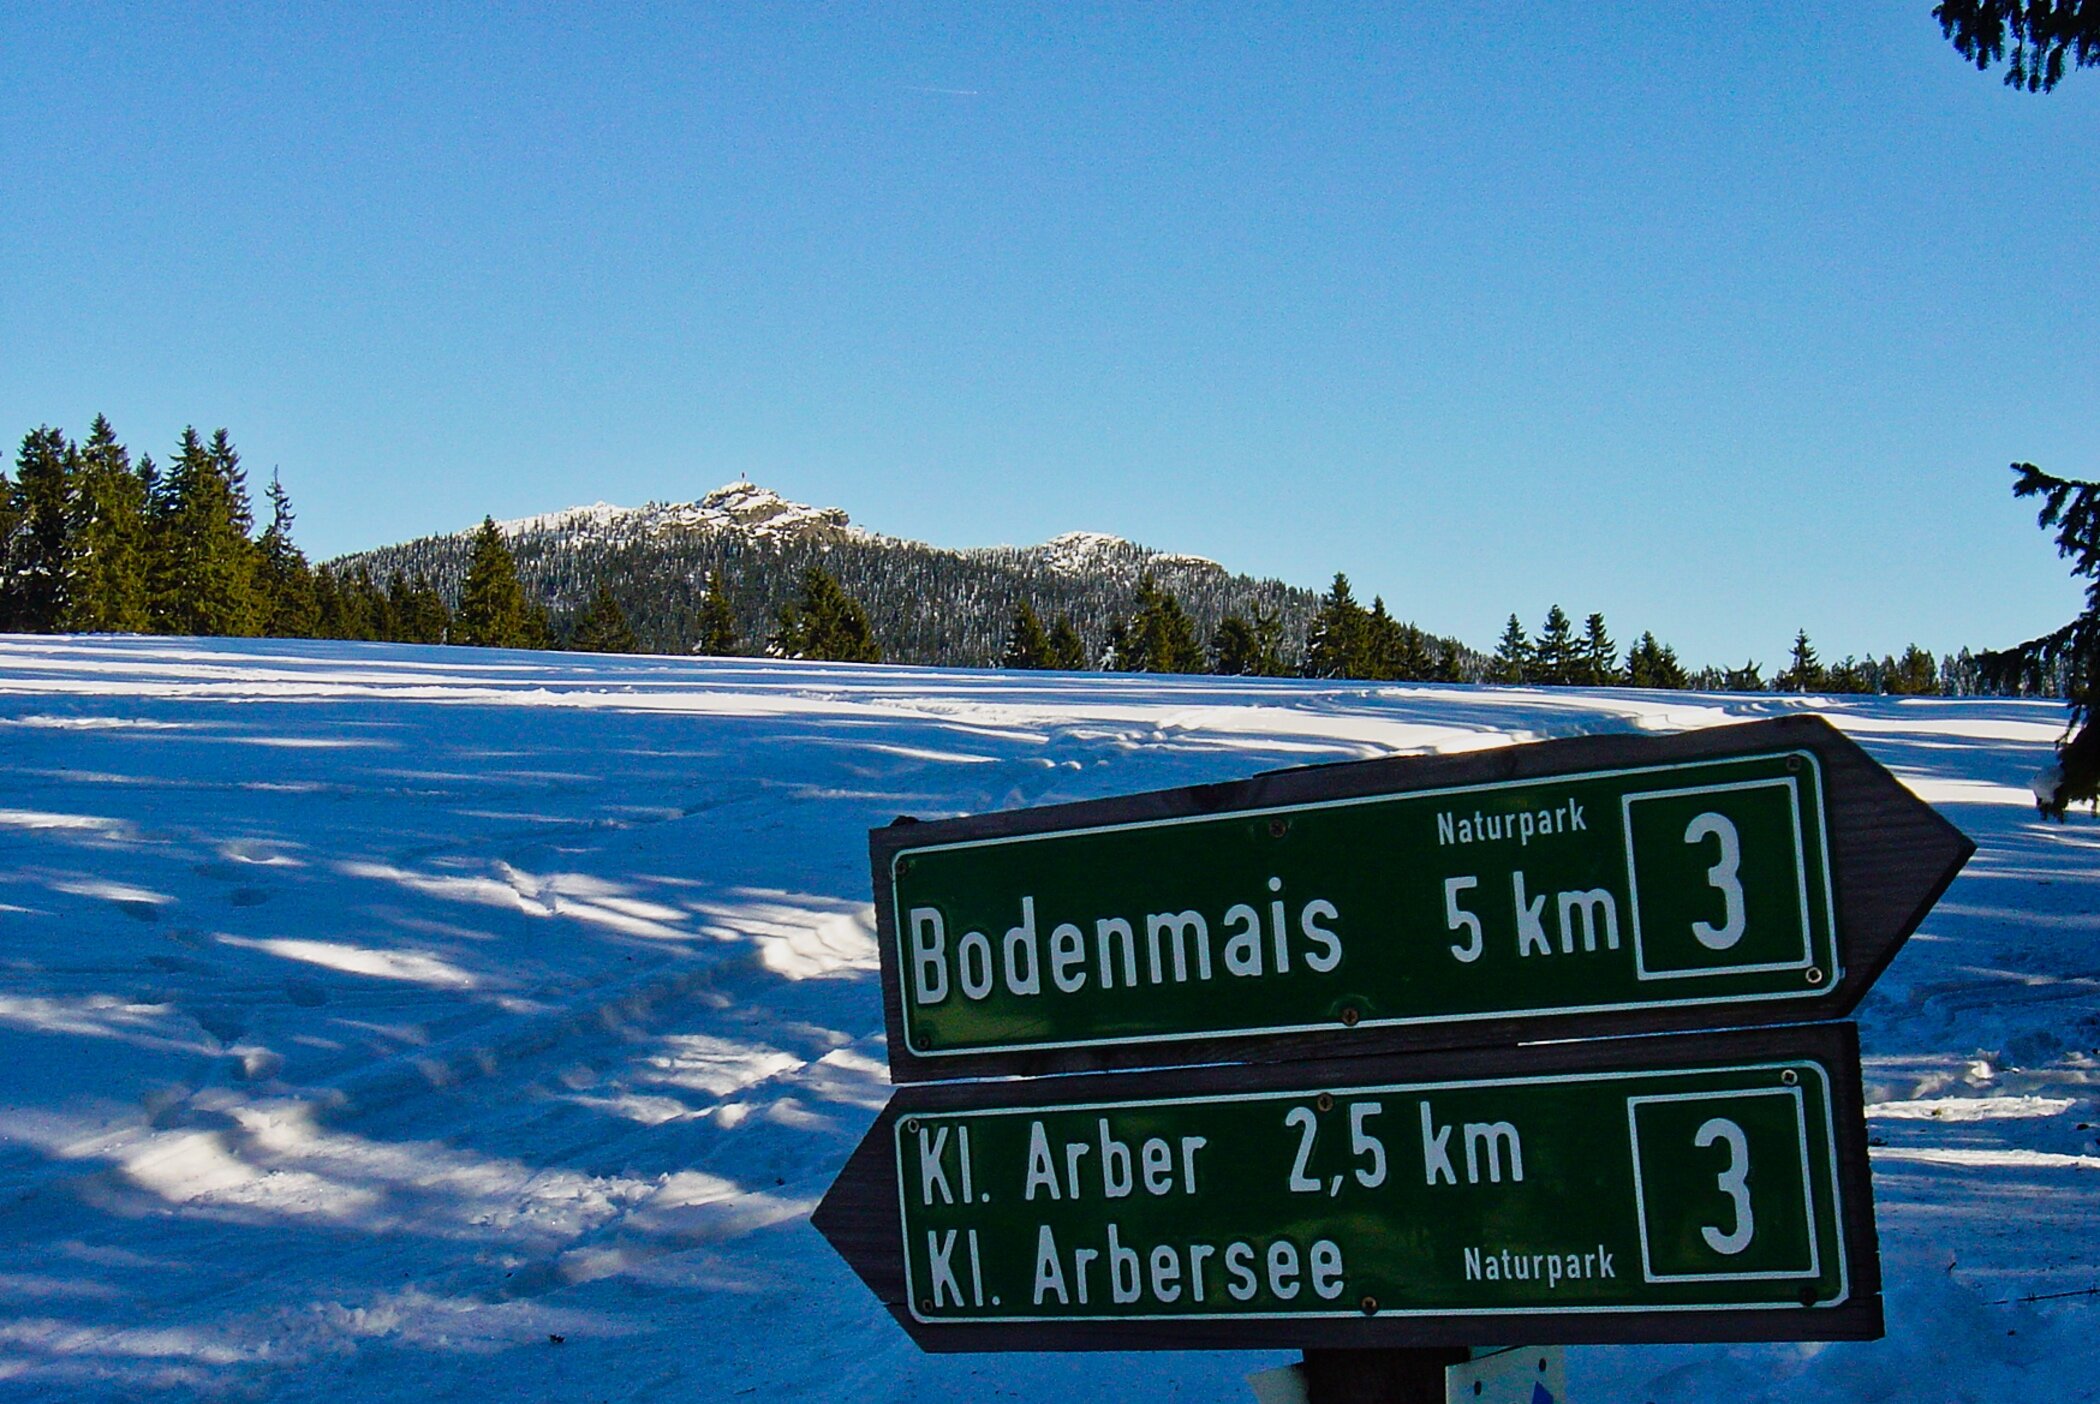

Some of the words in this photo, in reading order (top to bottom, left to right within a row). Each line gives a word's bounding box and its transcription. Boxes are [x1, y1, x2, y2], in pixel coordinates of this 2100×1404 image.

[1437, 798, 1587, 846] Naturpark
[1683, 811, 1746, 950] 3
[909, 876, 1343, 1004] Bodenmais
[1443, 875, 1484, 963] 5
[1512, 870, 1620, 957] km
[918, 1125, 990, 1205] Kl.
[1024, 1117, 1208, 1201] Arber
[1284, 1101, 1387, 1197] 2,5
[1419, 1100, 1524, 1186] km
[1693, 1116, 1754, 1255] 3
[926, 1228, 1001, 1308] Kl.
[1032, 1222, 1345, 1305] Arbersee
[1463, 1245, 1616, 1289] Naturpark
